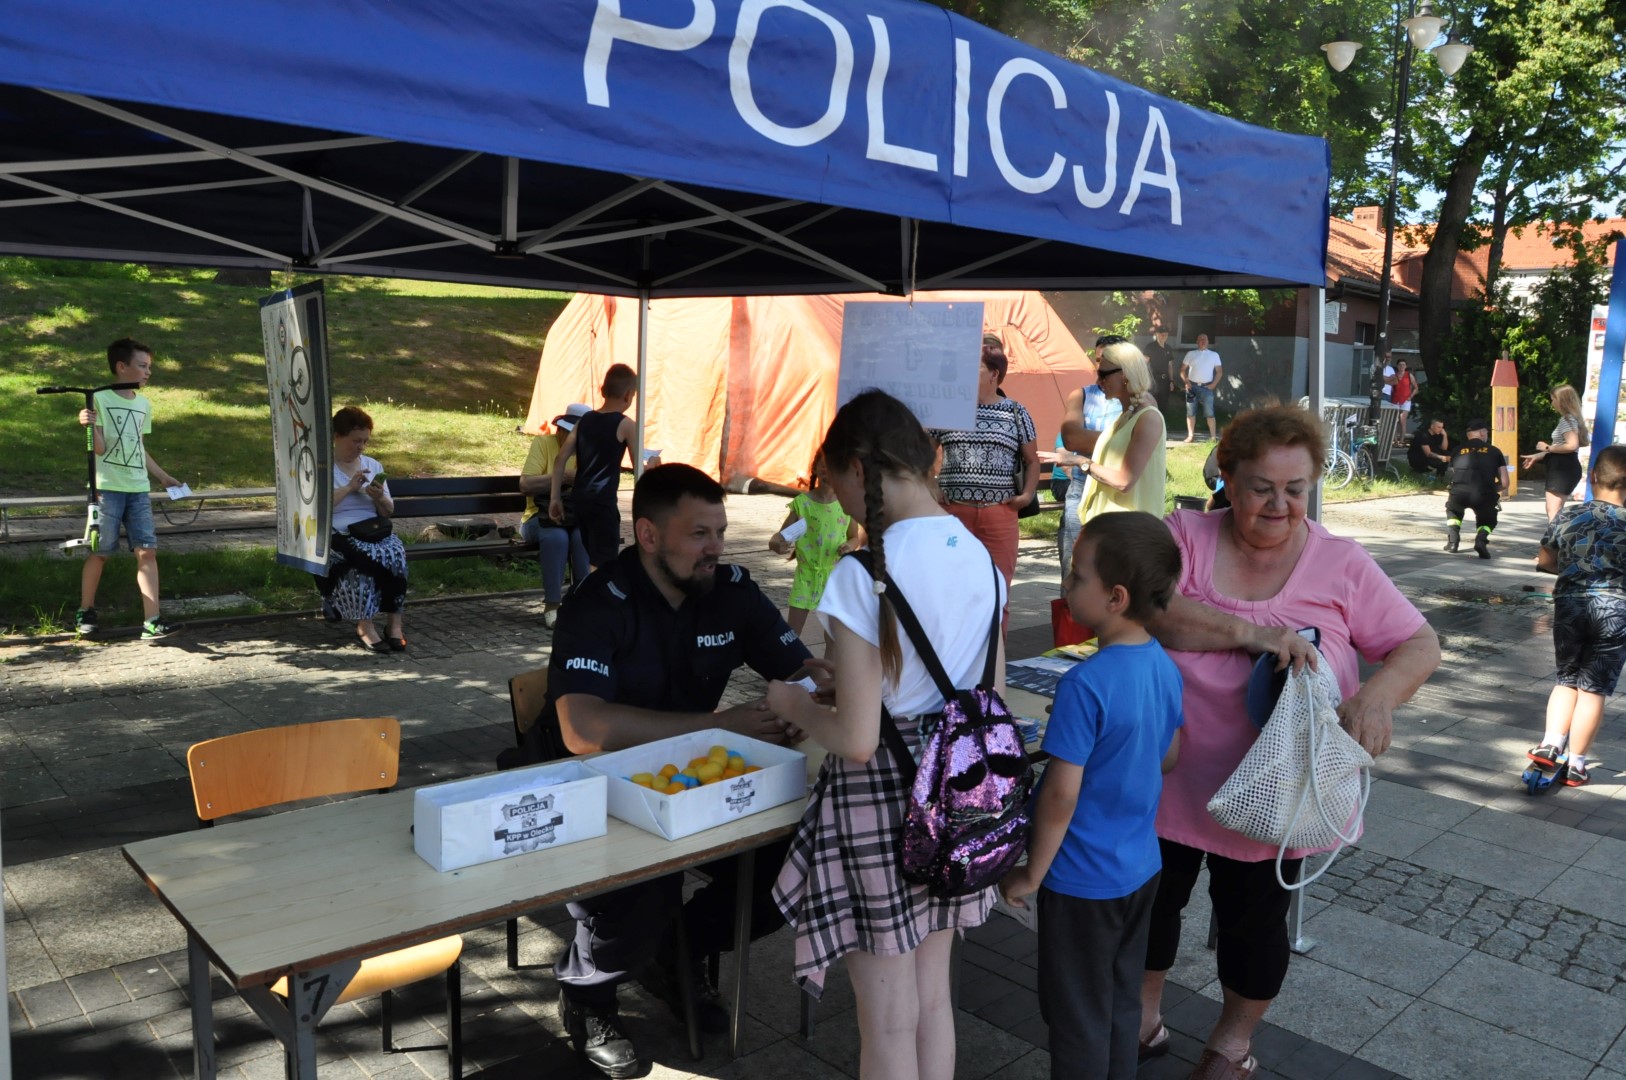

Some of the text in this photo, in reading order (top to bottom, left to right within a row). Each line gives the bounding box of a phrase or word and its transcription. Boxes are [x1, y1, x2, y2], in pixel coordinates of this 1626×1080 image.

[583, 0, 1183, 225] POLICJA
[697, 631, 735, 648] POLICJA
[566, 657, 609, 677] POLICJA
[511, 802, 546, 816] POLICJA
[506, 833, 522, 842] KPP
[303, 973, 331, 1016] 7
